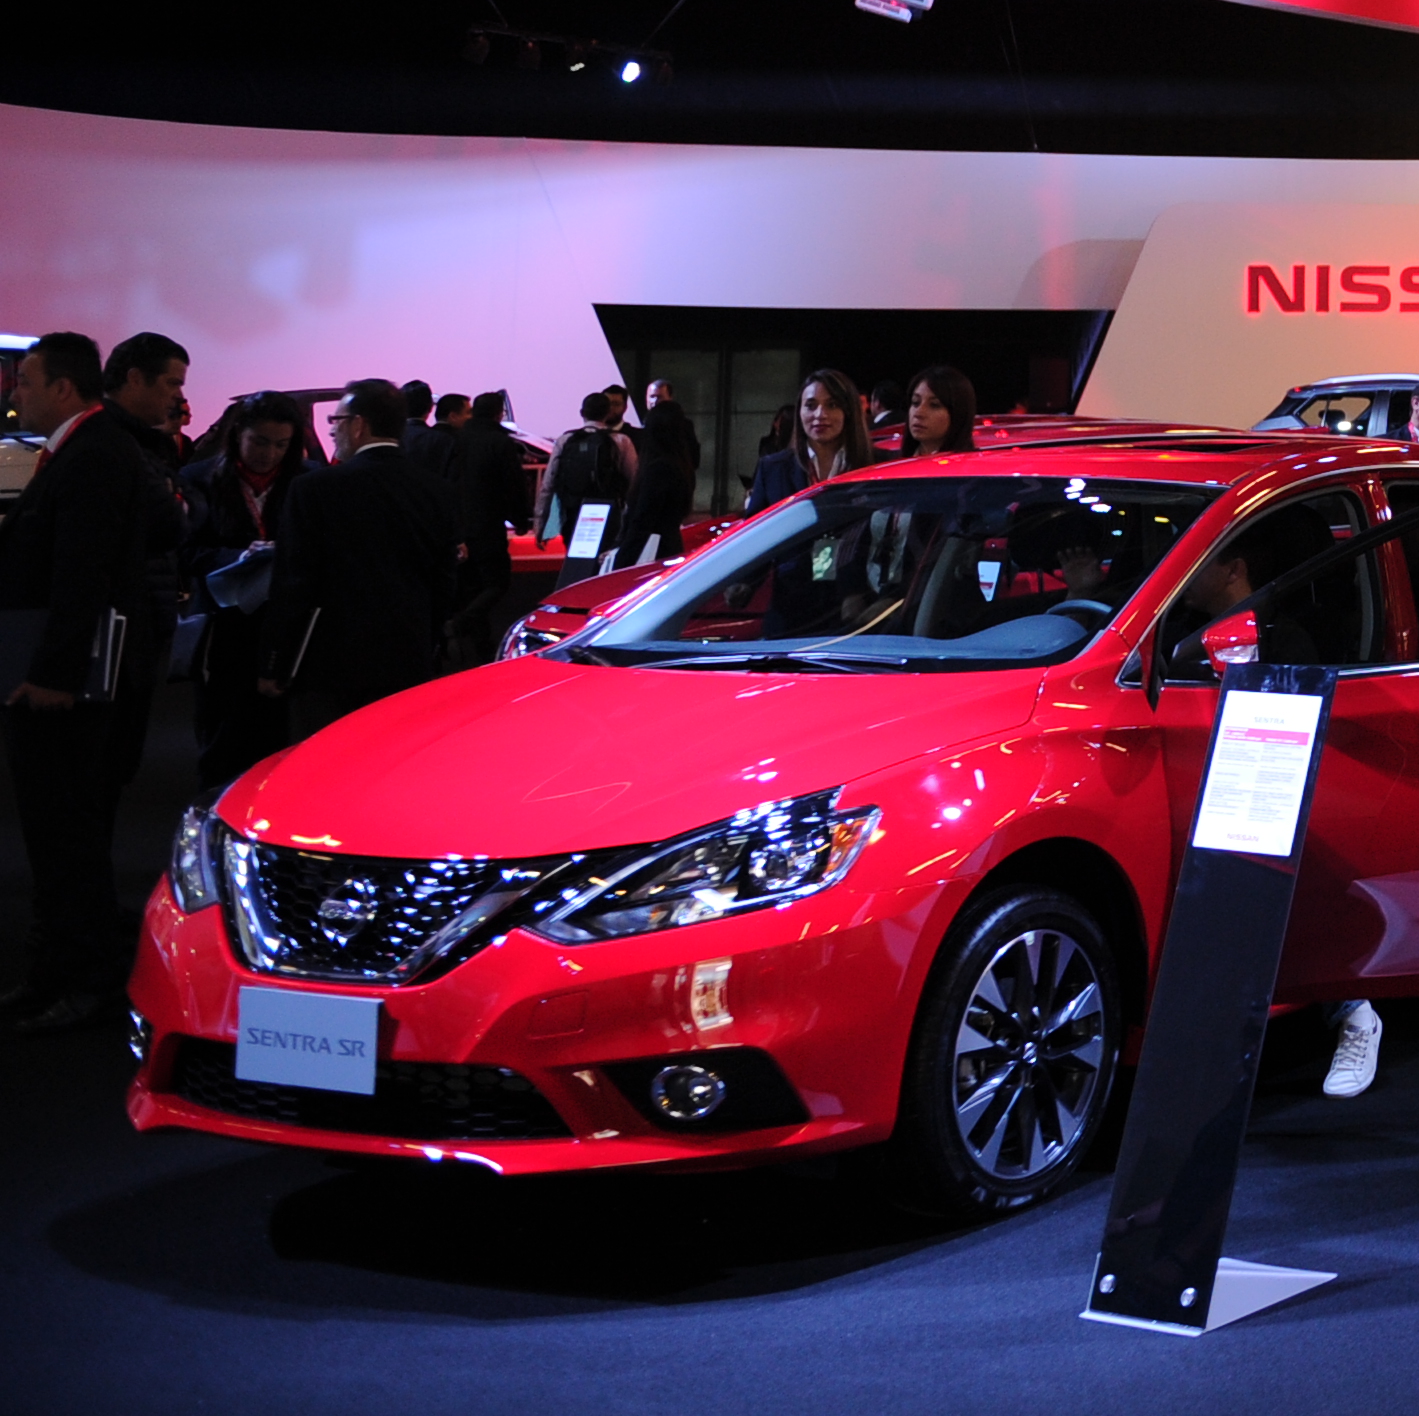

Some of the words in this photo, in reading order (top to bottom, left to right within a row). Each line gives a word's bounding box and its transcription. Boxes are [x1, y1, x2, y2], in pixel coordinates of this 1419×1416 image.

[1253, 716, 1285, 725] SENTRA
[1227, 833, 1259, 842] NISSAN
[246, 1027, 332, 1054] SENTRA
[337, 1038, 365, 1058] SR
